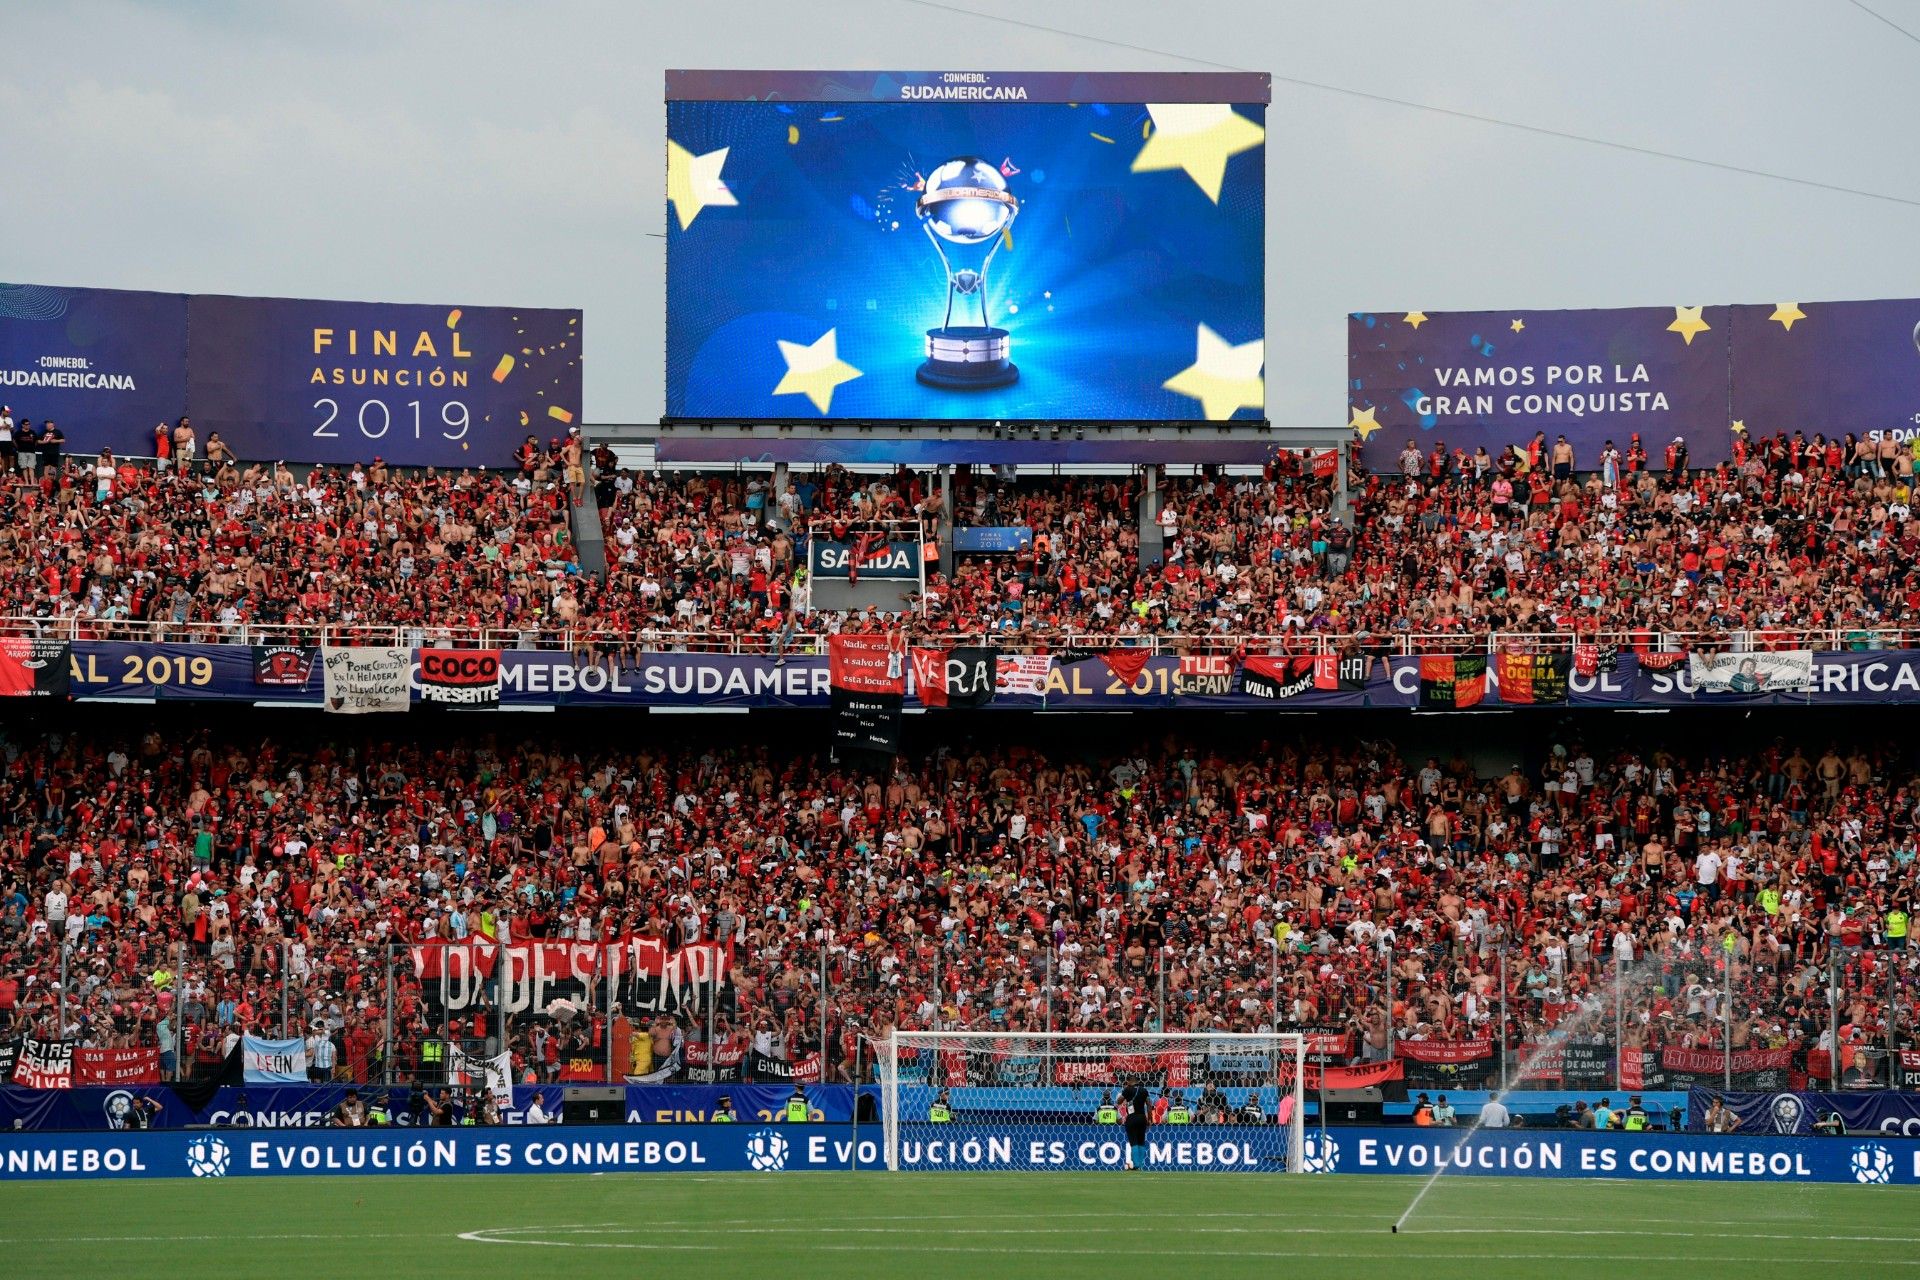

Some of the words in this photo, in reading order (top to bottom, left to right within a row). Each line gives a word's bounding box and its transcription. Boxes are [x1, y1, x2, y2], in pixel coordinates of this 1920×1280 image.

[901, 86, 1028, 100] SUDAMERICANA
[313, 328, 472, 358] FINAL
[0, 371, 136, 391] UDAMERICANA
[310, 366, 468, 387] ASUNCIÓN
[1434, 366, 1536, 387] VAMOS
[1547, 365, 1603, 385] POR
[1615, 363, 1650, 383] LA
[1416, 395, 1494, 415] GRAN
[1505, 392, 1670, 417] CONQUISTA
[312, 398, 470, 440] 2019
[843, 640, 868, 649] Nadie
[121, 655, 213, 685] 2019
[423, 656, 497, 678] COCO
[851, 658, 873, 667] salvo
[843, 675, 861, 684] esta
[864, 675, 892, 686] locura
[1245, 680, 1274, 698] VILLA
[421, 683, 500, 703] PRESENTE
[257, 1051, 293, 1073] LEÓN
[1559, 1050, 1572, 1058] ME
[1575, 1050, 1593, 1058] VAN
[570, 1058, 593, 1072] PEDRO
[1065, 1062, 1105, 1073] PELADO
[1567, 1061, 1579, 1069] DE
[1581, 1061, 1607, 1069] AMOR
[14, 1064, 70, 1088] PAIVA
[0, 1149, 146, 1172] NMEBOL
[250, 1140, 456, 1169] EVOLUCIÓN
[476, 1144, 512, 1166] ES
[525, 1142, 706, 1166] CONMEBOL
[808, 1136, 1011, 1164] EVOUCIÓN
[1031, 1141, 1065, 1163] ES
[1581, 1148, 1616, 1171] ES
[1630, 1149, 1811, 1175] CONMEBOL
